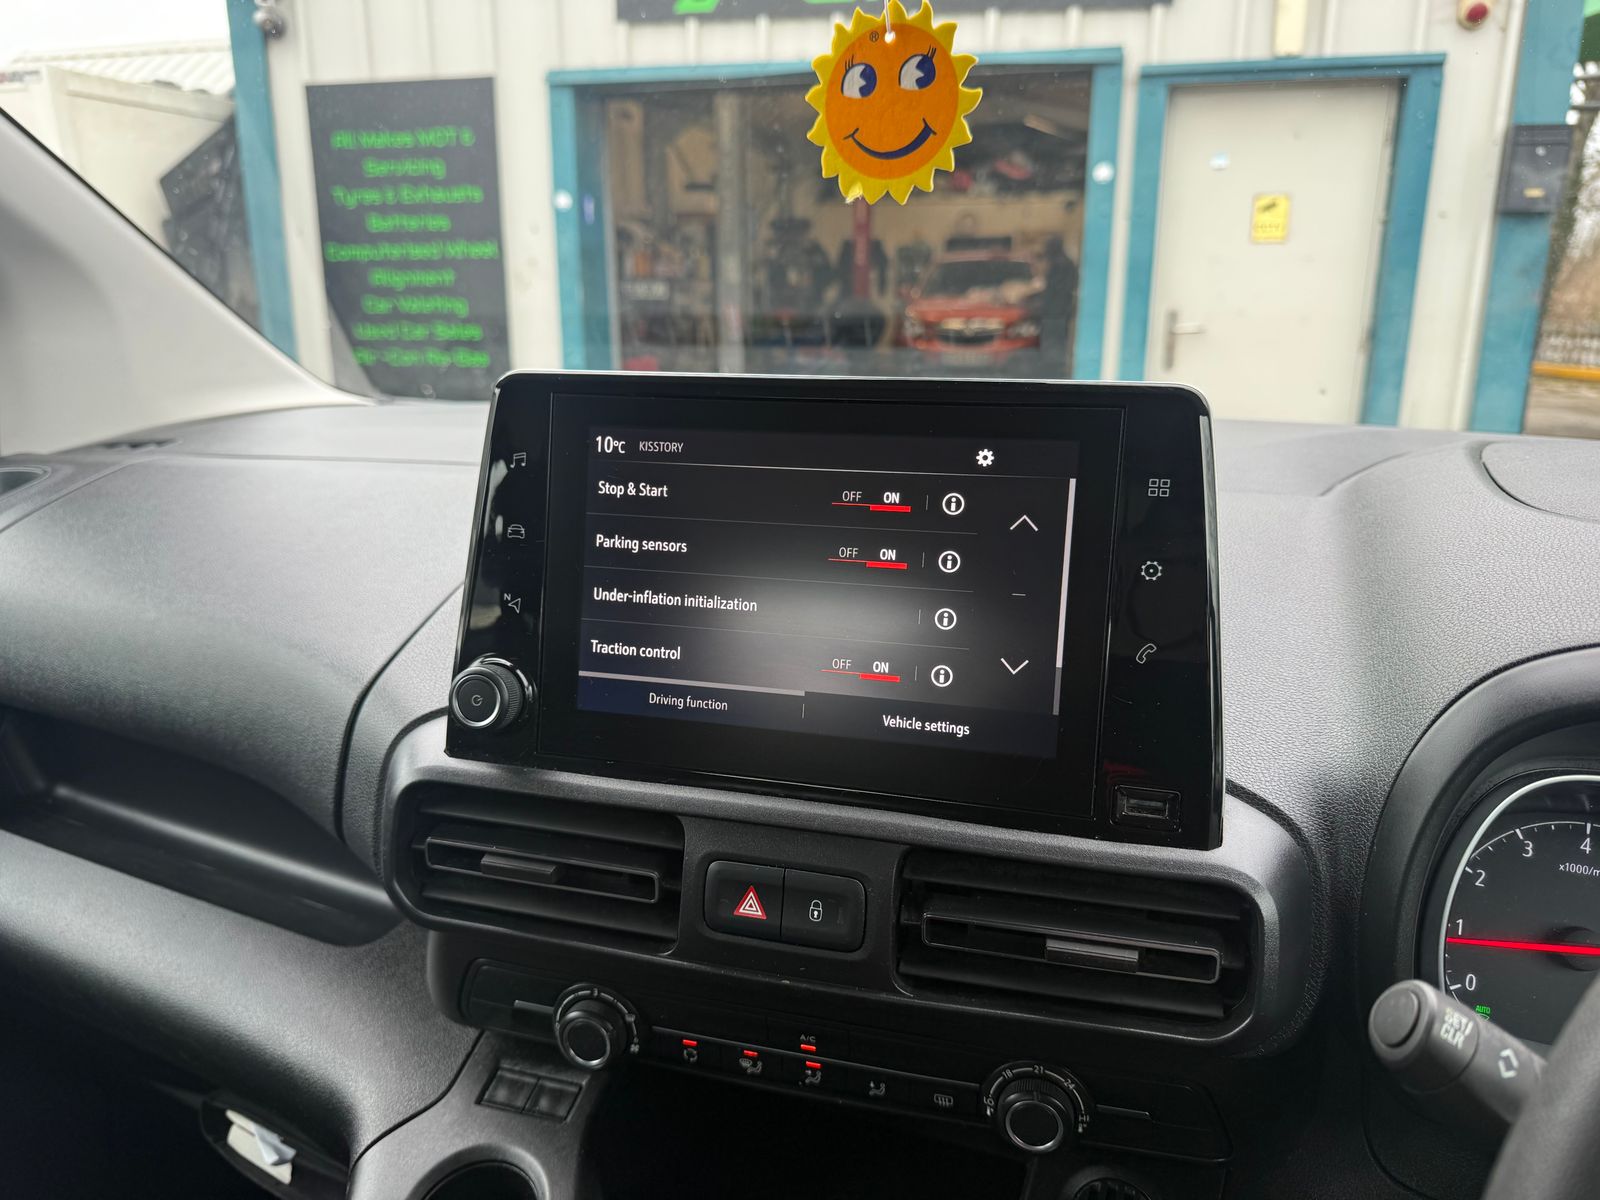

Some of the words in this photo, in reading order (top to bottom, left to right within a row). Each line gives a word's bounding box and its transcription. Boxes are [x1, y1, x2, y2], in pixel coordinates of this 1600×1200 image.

[362, 157, 447, 180] Servicing
[366, 213, 451, 232] Batteries
[638, 441, 685, 453] KISSTORY
[598, 480, 625, 499] Stop
[627, 482, 637, 497] &
[639, 482, 669, 498] Start
[842, 490, 863, 503] OFF
[883, 492, 901, 505] ON
[596, 533, 640, 554] Parking
[641, 540, 688, 553] sensors
[838, 547, 859, 559] OFF
[879, 549, 897, 561] ON
[503, 592, 512, 601] N
[593, 586, 682, 607] Under-inflation
[684, 594, 758, 613] initialization
[590, 639, 638, 657] Traction
[639, 646, 681, 661] control
[832, 658, 853, 671] OFF
[872, 661, 890, 674] ON
[649, 692, 684, 710] Driving
[686, 696, 729, 712] function
[882, 714, 922, 730] Vehicle
[924, 722, 970, 737] settings
[1522, 840, 1534, 858] 3
[1580, 837, 1592, 855] 4
[1475, 869, 1486, 887] 2
[1456, 918, 1464, 936] 1
[1465, 973, 1477, 991] 0
[1475, 1005, 1491, 1014] AUTO
[800, 1034, 816, 1042] A/C
[1033, 1064, 1045, 1074] 21
[1064, 1079, 1075, 1089] 24
